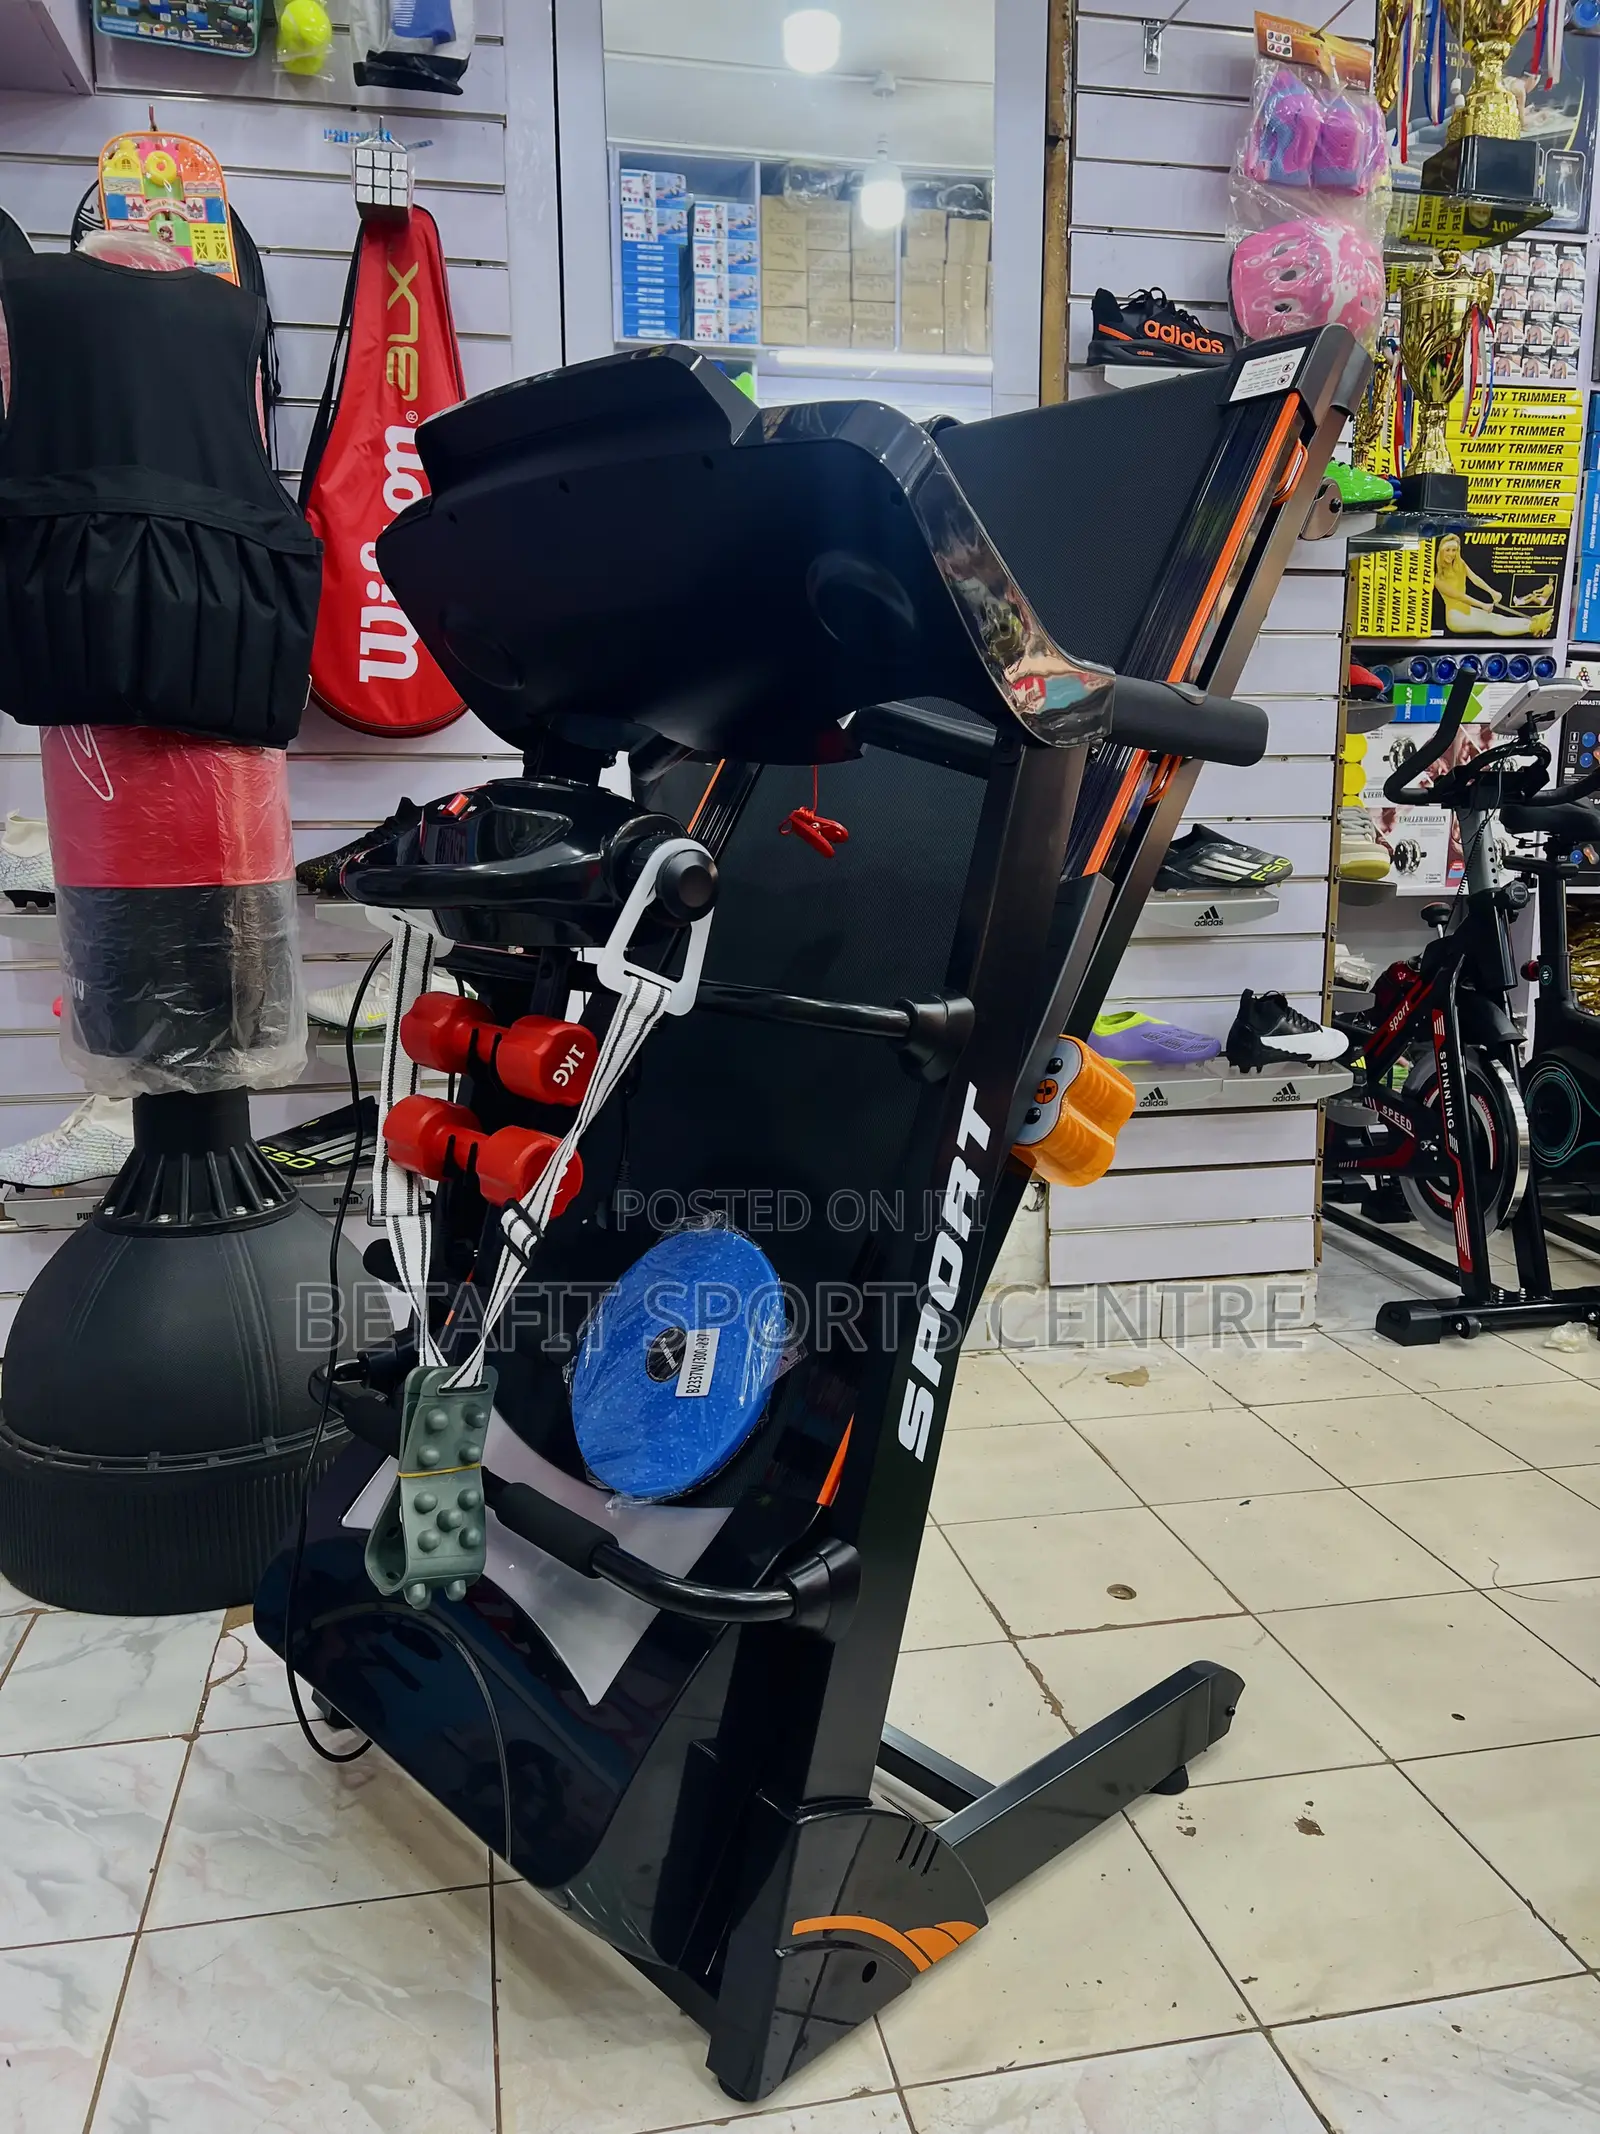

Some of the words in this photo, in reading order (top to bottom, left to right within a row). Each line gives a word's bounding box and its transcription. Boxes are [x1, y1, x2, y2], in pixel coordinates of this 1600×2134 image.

[1144, 320, 1224, 354] adidas
[1512, 392, 1567, 403] TRIMMER
[1510, 426, 1566, 437] TRIMMER
[1460, 443, 1505, 453] TUMMY
[1508, 444, 1564, 455] TRIMMER
[1460, 460, 1505, 470] TUMMY
[1508, 461, 1564, 472] TRIMMER
[1468, 478, 1502, 488] UMMY
[1506, 479, 1561, 490] TRIMMER
[1467, 494, 1502, 505] UMMY
[1504, 495, 1560, 507] TRIMMER
[1501, 513, 1556, 523] TRIMMER
[1464, 532, 1509, 545] TUMMY
[1511, 533, 1567, 545] TRIMMER
[1422, 537, 1433, 585] TRIMME
[1360, 575, 1371, 633] TRIMMER
[1376, 575, 1387, 633] TRIMMER
[1391, 587, 1402, 633] TUMMY
[1406, 586, 1417, 633] TUMMY
[1420, 588, 1431, 634] TUMMY
[1251, 857, 1291, 881] F50
[1194, 919, 1223, 927] adidas
[1388, 1000, 1410, 1032] sport
[552, 1043, 586, 1087] 1KG
[1139, 1098, 1168, 1107] adidas
[1272, 1094, 1300, 1103] adidas
[1439, 1051, 1455, 1129] SPINNING
[1381, 1105, 1412, 1131] SPEED
[1476, 1095, 1496, 1132] MOVEMENT
[897, 1081, 991, 1463] SPORT
